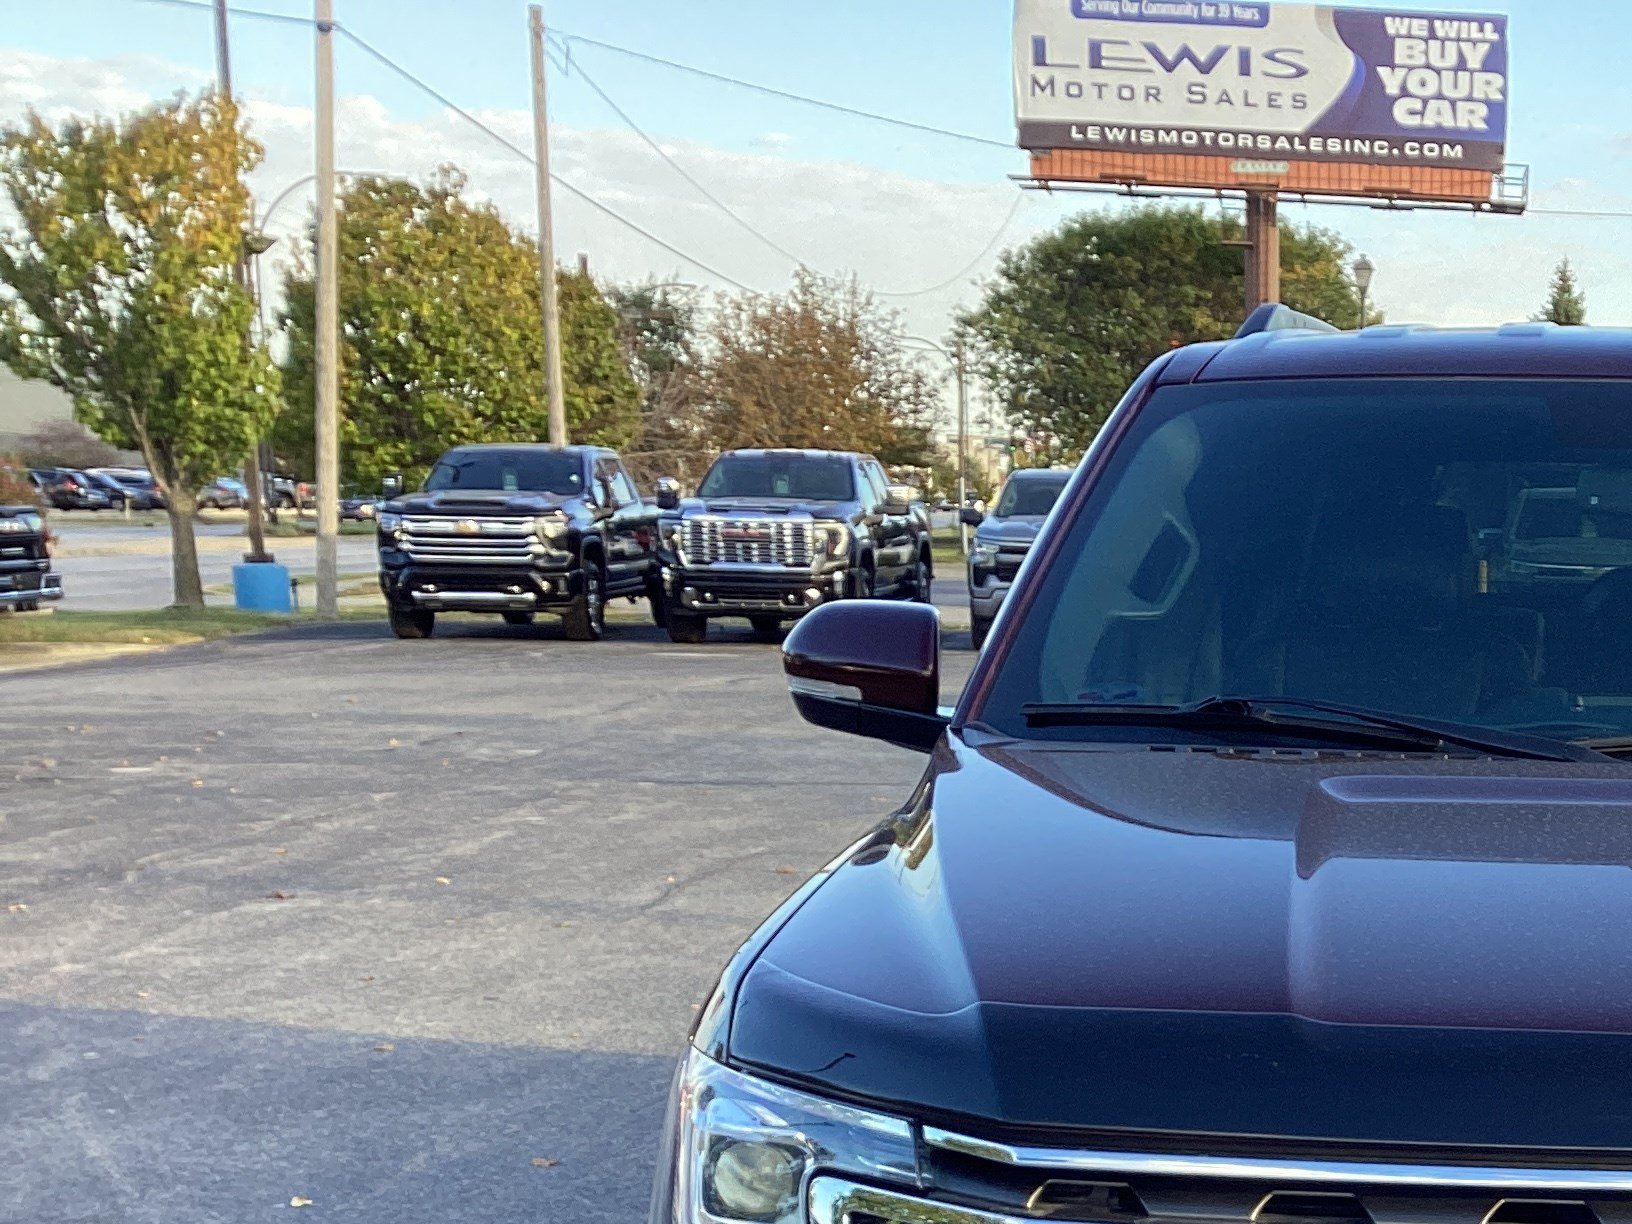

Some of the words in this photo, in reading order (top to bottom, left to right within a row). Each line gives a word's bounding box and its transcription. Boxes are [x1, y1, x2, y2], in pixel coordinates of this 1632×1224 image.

[1081, 0, 1120, 16] Serving
[1121, 0, 1140, 14] Our
[1141, 0, 1199, 19] Community
[1201, 2, 1217, 17] for
[1232, 5, 1260, 20] Years
[1384, 16, 1430, 37] WE
[1433, 19, 1500, 41] WILL
[1031, 34, 1309, 79] LEWIS
[1394, 37, 1491, 69] BUY
[1030, 74, 1162, 103] MOTOR
[1186, 82, 1308, 109] SALES
[1376, 65, 1505, 100] YOUR
[1392, 96, 1490, 130] CAR
[1070, 124, 1464, 159] LEWISMOTORSALESINC.COM
